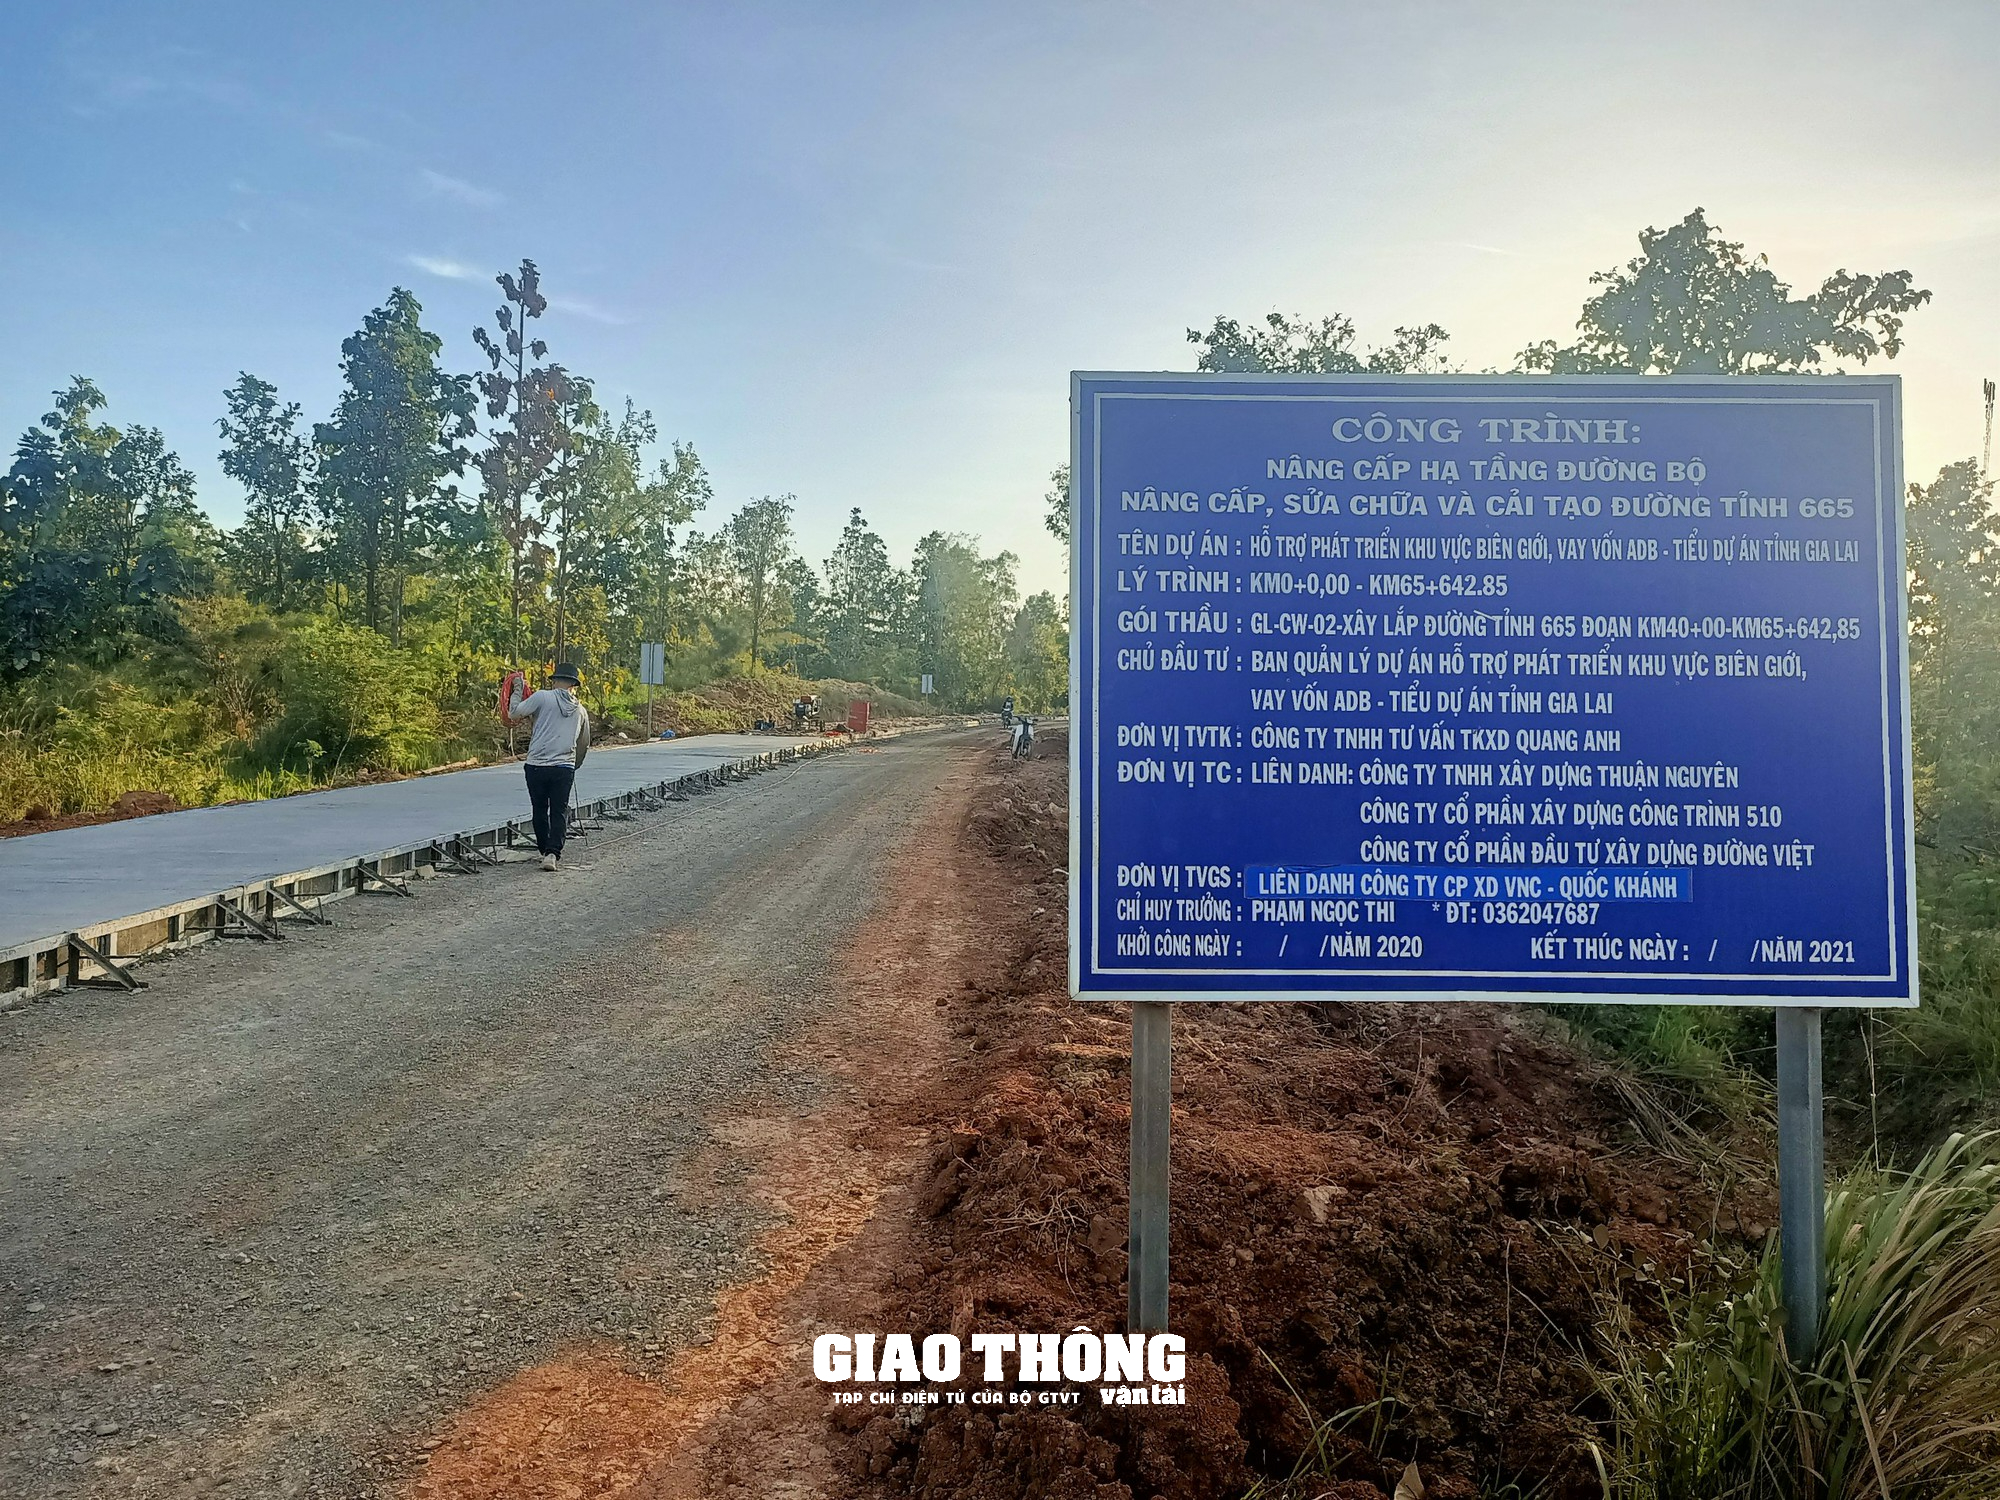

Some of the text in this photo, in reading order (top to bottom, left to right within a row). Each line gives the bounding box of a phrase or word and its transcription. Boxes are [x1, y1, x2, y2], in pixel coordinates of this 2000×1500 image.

[1332, 412, 1641, 446] CÔNG TRÌNH:
[1267, 452, 1707, 487] NÂNG CẤP HẠ TẦNG ĐƯỜNG BỘ
[1121, 486, 1854, 520] NÂNG CẤP, SỬA CHỮA VÀ CẢI TẠO ĐƯỜNG TỈNH 665
[1118, 524, 1859, 564] TÊN DỰ ÁN HỖ TRỢ PHÁT TRIỂN KHU BIÊN GIỚI, VAY VỐN ADB TIỂU TỈNH GIA LAI
[1118, 565, 1507, 598] LÝ TRÌNH KM0+0,00 KM65+642.85
[1118, 602, 1860, 642] GÓI THẦU GL-CW-02-XÂY LẮP ĐƯỜNG TỈNH 665 ĐOẠN KM40+00-KM65+642,85
[1118, 640, 1806, 681] CHỦ ĐẦU TƯ BAN QUẢN LÝ DỰ ÁN HỖ TRỢ PHÁT TRIỂN KHU VỰC BIÊN GIỚI,
[1251, 680, 1613, 716] VAY VỐN ADB TIỂU DỰ ÁN TỈNH GIA LAI
[1118, 720, 1620, 754] ĐƠN VỊ TVTK CÔNG TY TNHH TƯ VẤN TKXD QUANG ANH
[1117, 757, 1738, 791] ĐƠN VỊ TC LIÊN DANH: CÔNG TY TNHH XÂY DỰNG THUẬN NGUYÊN
[1360, 792, 1782, 830] CÔNG TY CỔ PHẦN XÂY DỰNG CÔNG TRÌNH 510
[1360, 830, 1814, 870] CÔNG TY CỔ PHẦN ĐẦU TƯ XÂY DỰNG ĐƯỜNG VIỆT
[1117, 863, 1677, 901] ĐƠN VỊ TVGS LIÊN DANH CÔNG TY CP XD VNC QUỐC KHÁNH
[1117, 891, 1600, 927] CHỈ HUY TRƯỞNG PHẠM NGỌC THI 0362047687
[1118, 926, 1855, 963] KHỞI CÔNG NGÀY 2020 KẾT THÚC NGÀY 2021
